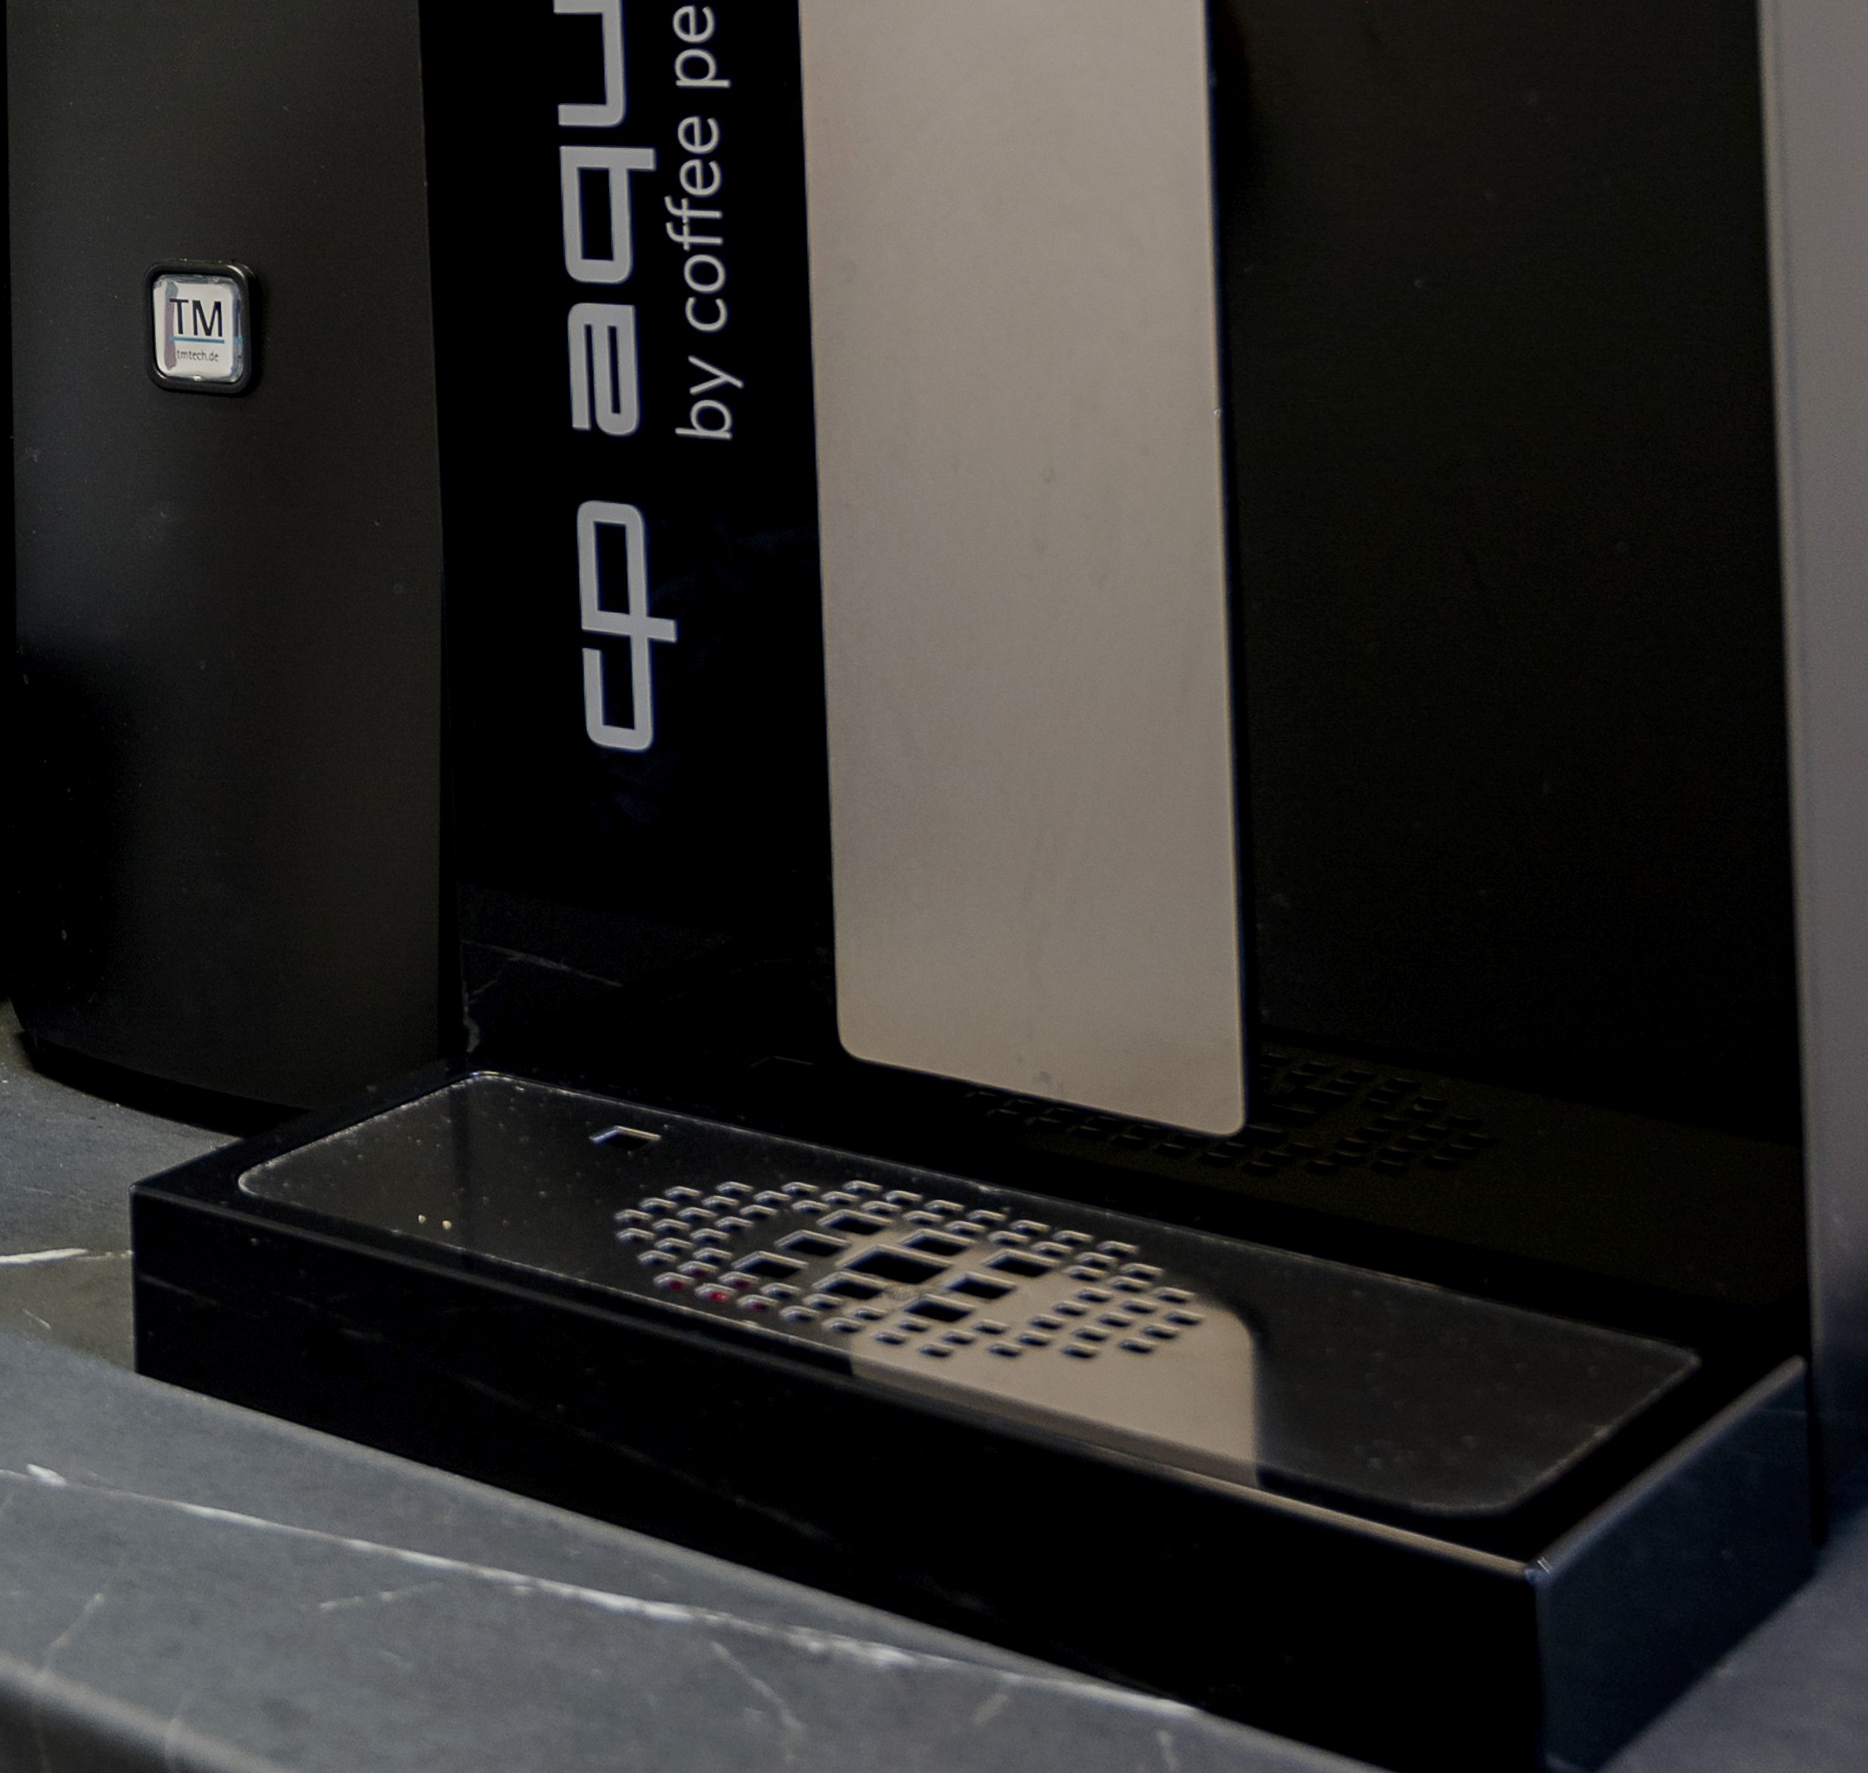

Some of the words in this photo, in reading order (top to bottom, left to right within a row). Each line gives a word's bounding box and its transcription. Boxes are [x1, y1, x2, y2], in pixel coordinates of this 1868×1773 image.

[664, 116, 728, 332] coffee
[169, 298, 223, 337] TM
[176, 349, 220, 362] tmtech.de
[674, 355, 744, 440] by
[576, 500, 678, 752] cp
